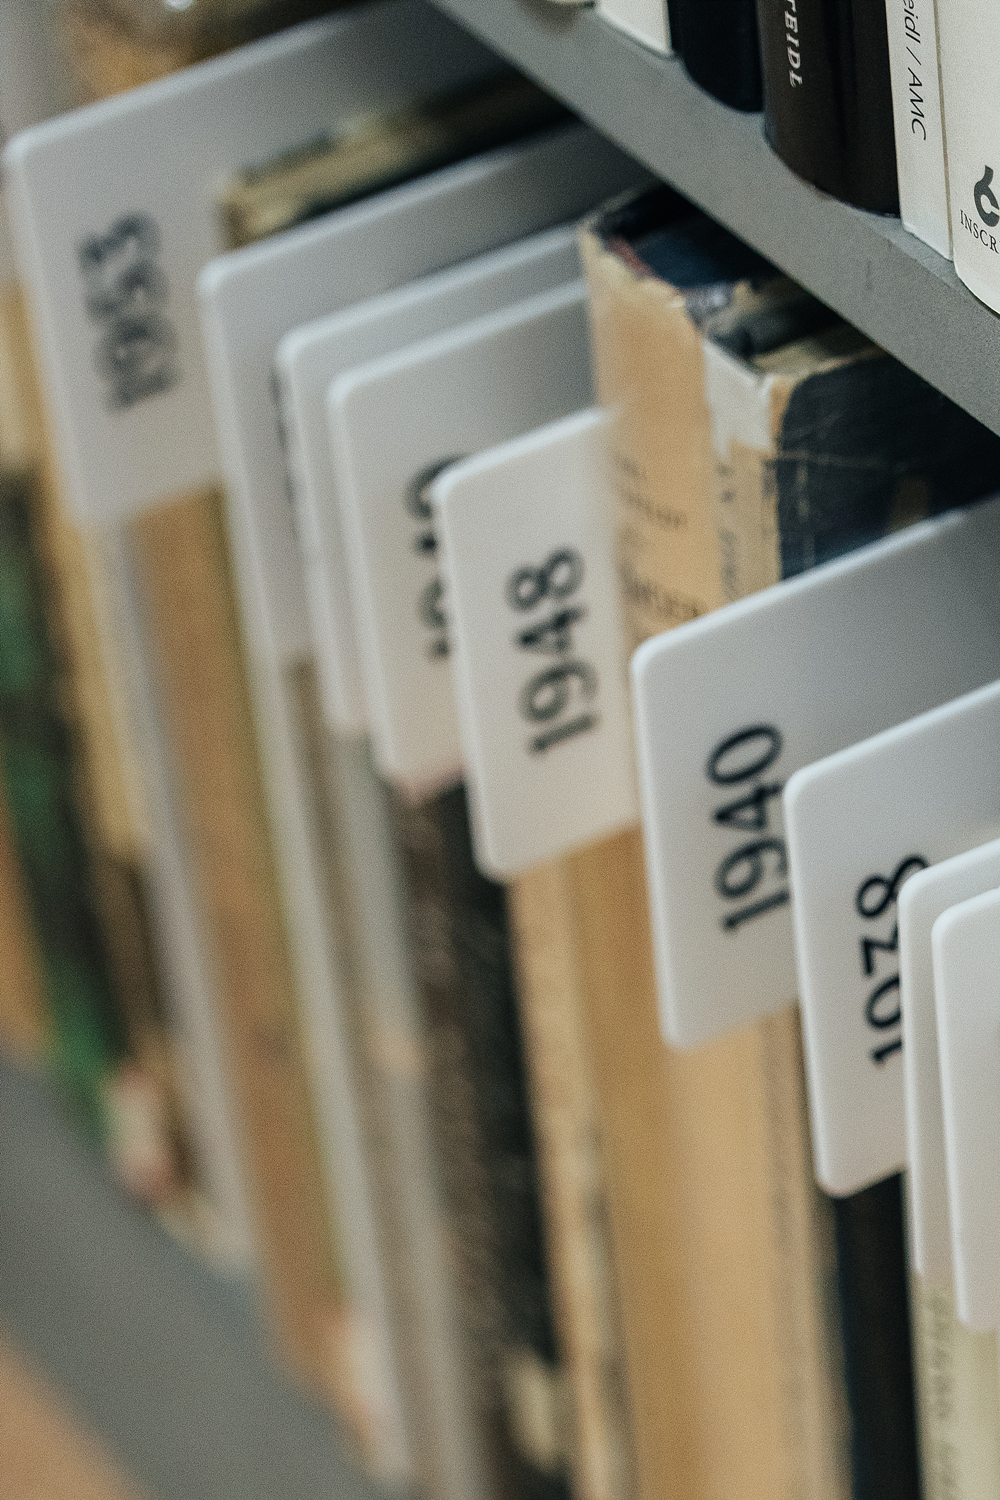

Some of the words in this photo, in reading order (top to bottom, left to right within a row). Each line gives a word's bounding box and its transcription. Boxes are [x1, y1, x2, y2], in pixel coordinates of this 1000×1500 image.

[907, 67, 927, 141] AMC
[506, 546, 600, 757] 1948
[705, 723, 788, 931] 1940
